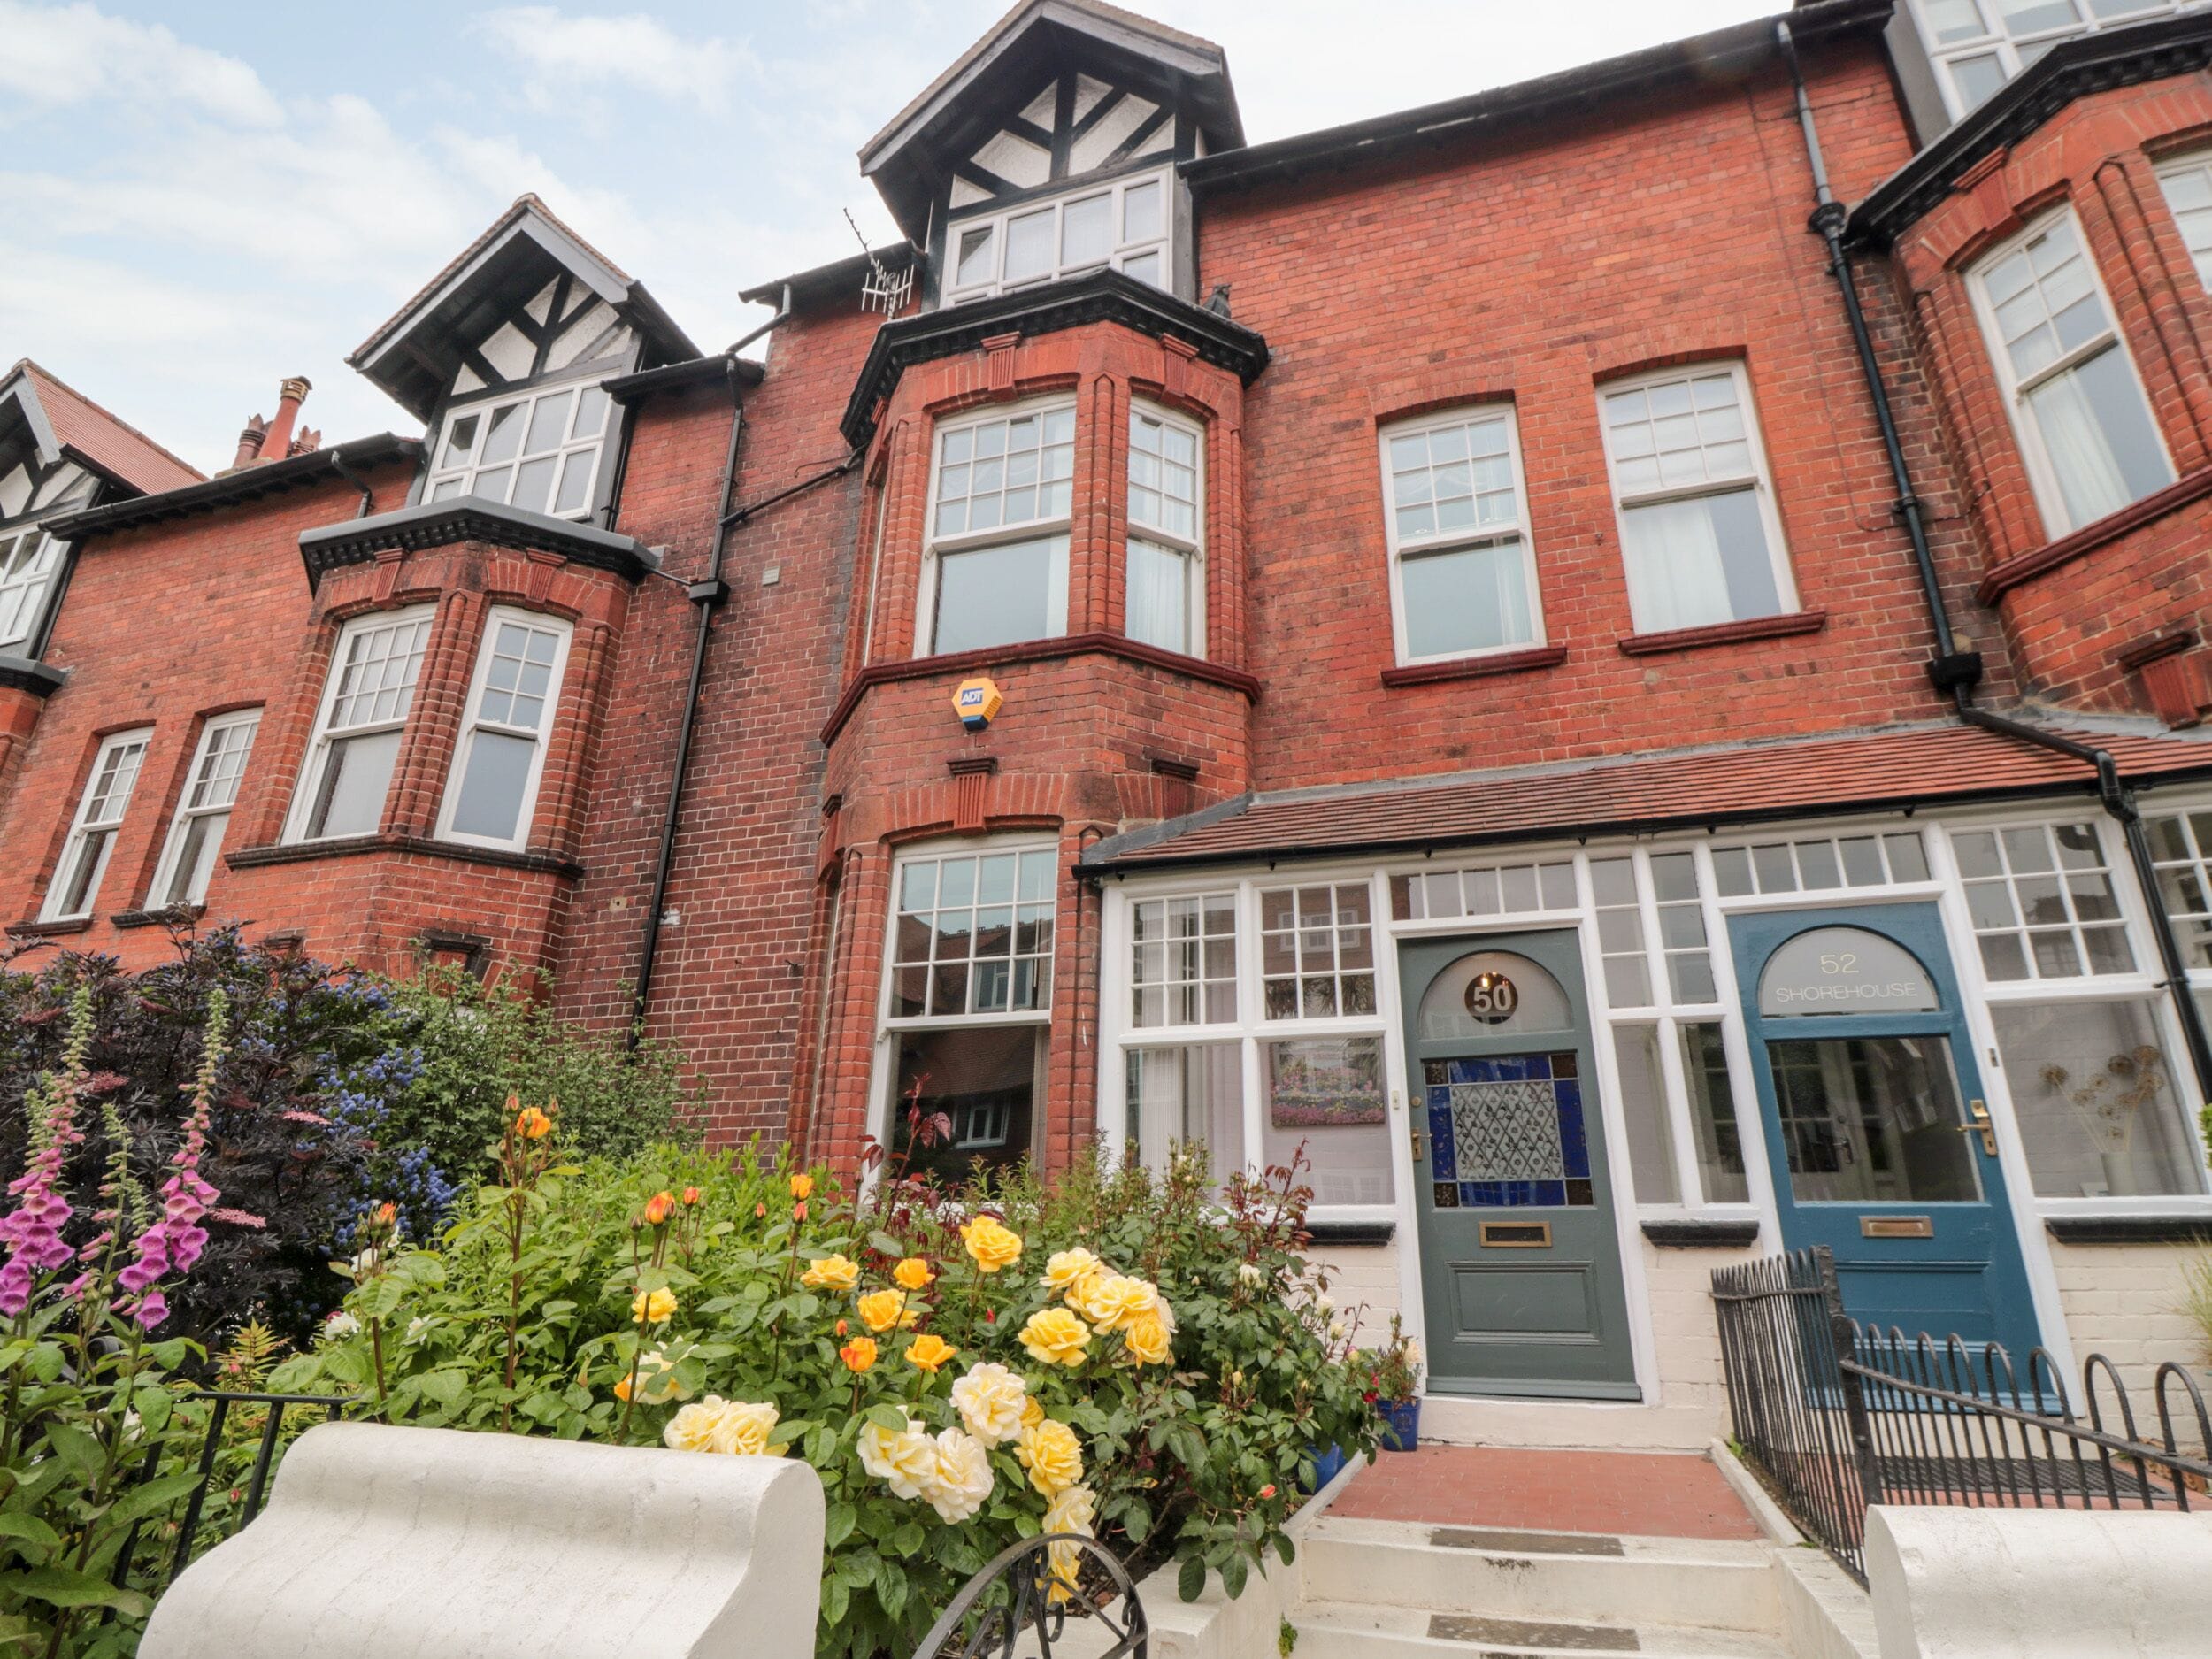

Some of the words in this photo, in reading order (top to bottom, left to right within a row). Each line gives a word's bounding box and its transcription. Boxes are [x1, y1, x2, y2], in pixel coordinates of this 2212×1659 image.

[962, 689, 983, 703] ADT
[1820, 953, 1860, 974] 52
[1473, 984, 1512, 1013] 50
[1776, 982, 1917, 1002] SHOREHOUSE
